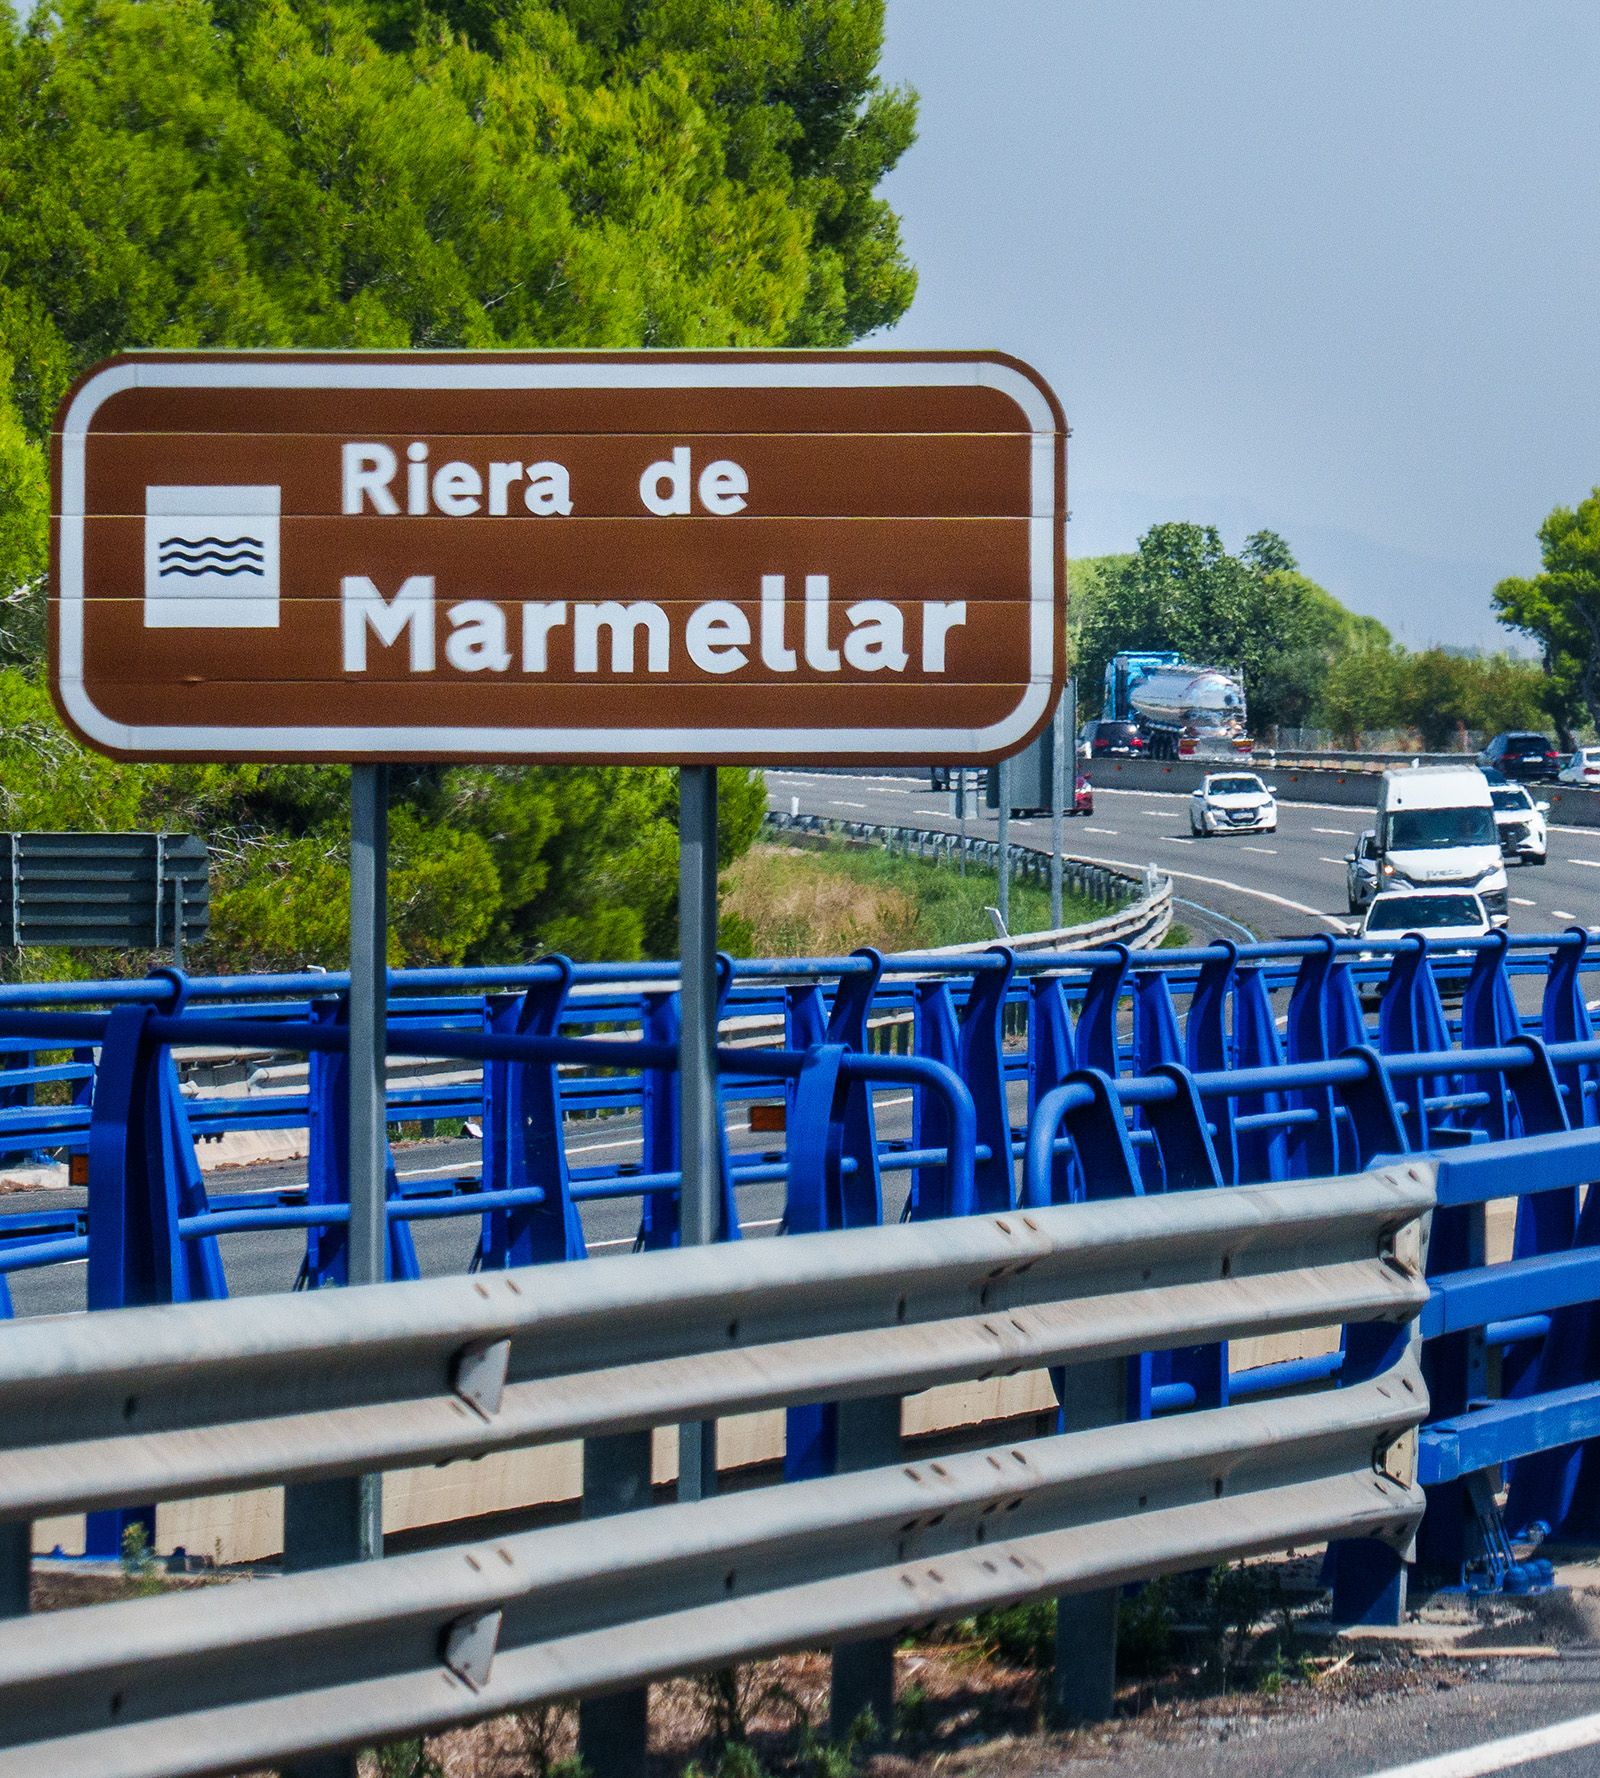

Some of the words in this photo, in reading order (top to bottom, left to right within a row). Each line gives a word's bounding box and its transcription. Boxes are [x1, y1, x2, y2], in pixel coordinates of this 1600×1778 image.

[341, 442, 573, 517] Riera
[638, 446, 750, 517] de
[341, 574, 967, 674] Marmellar
